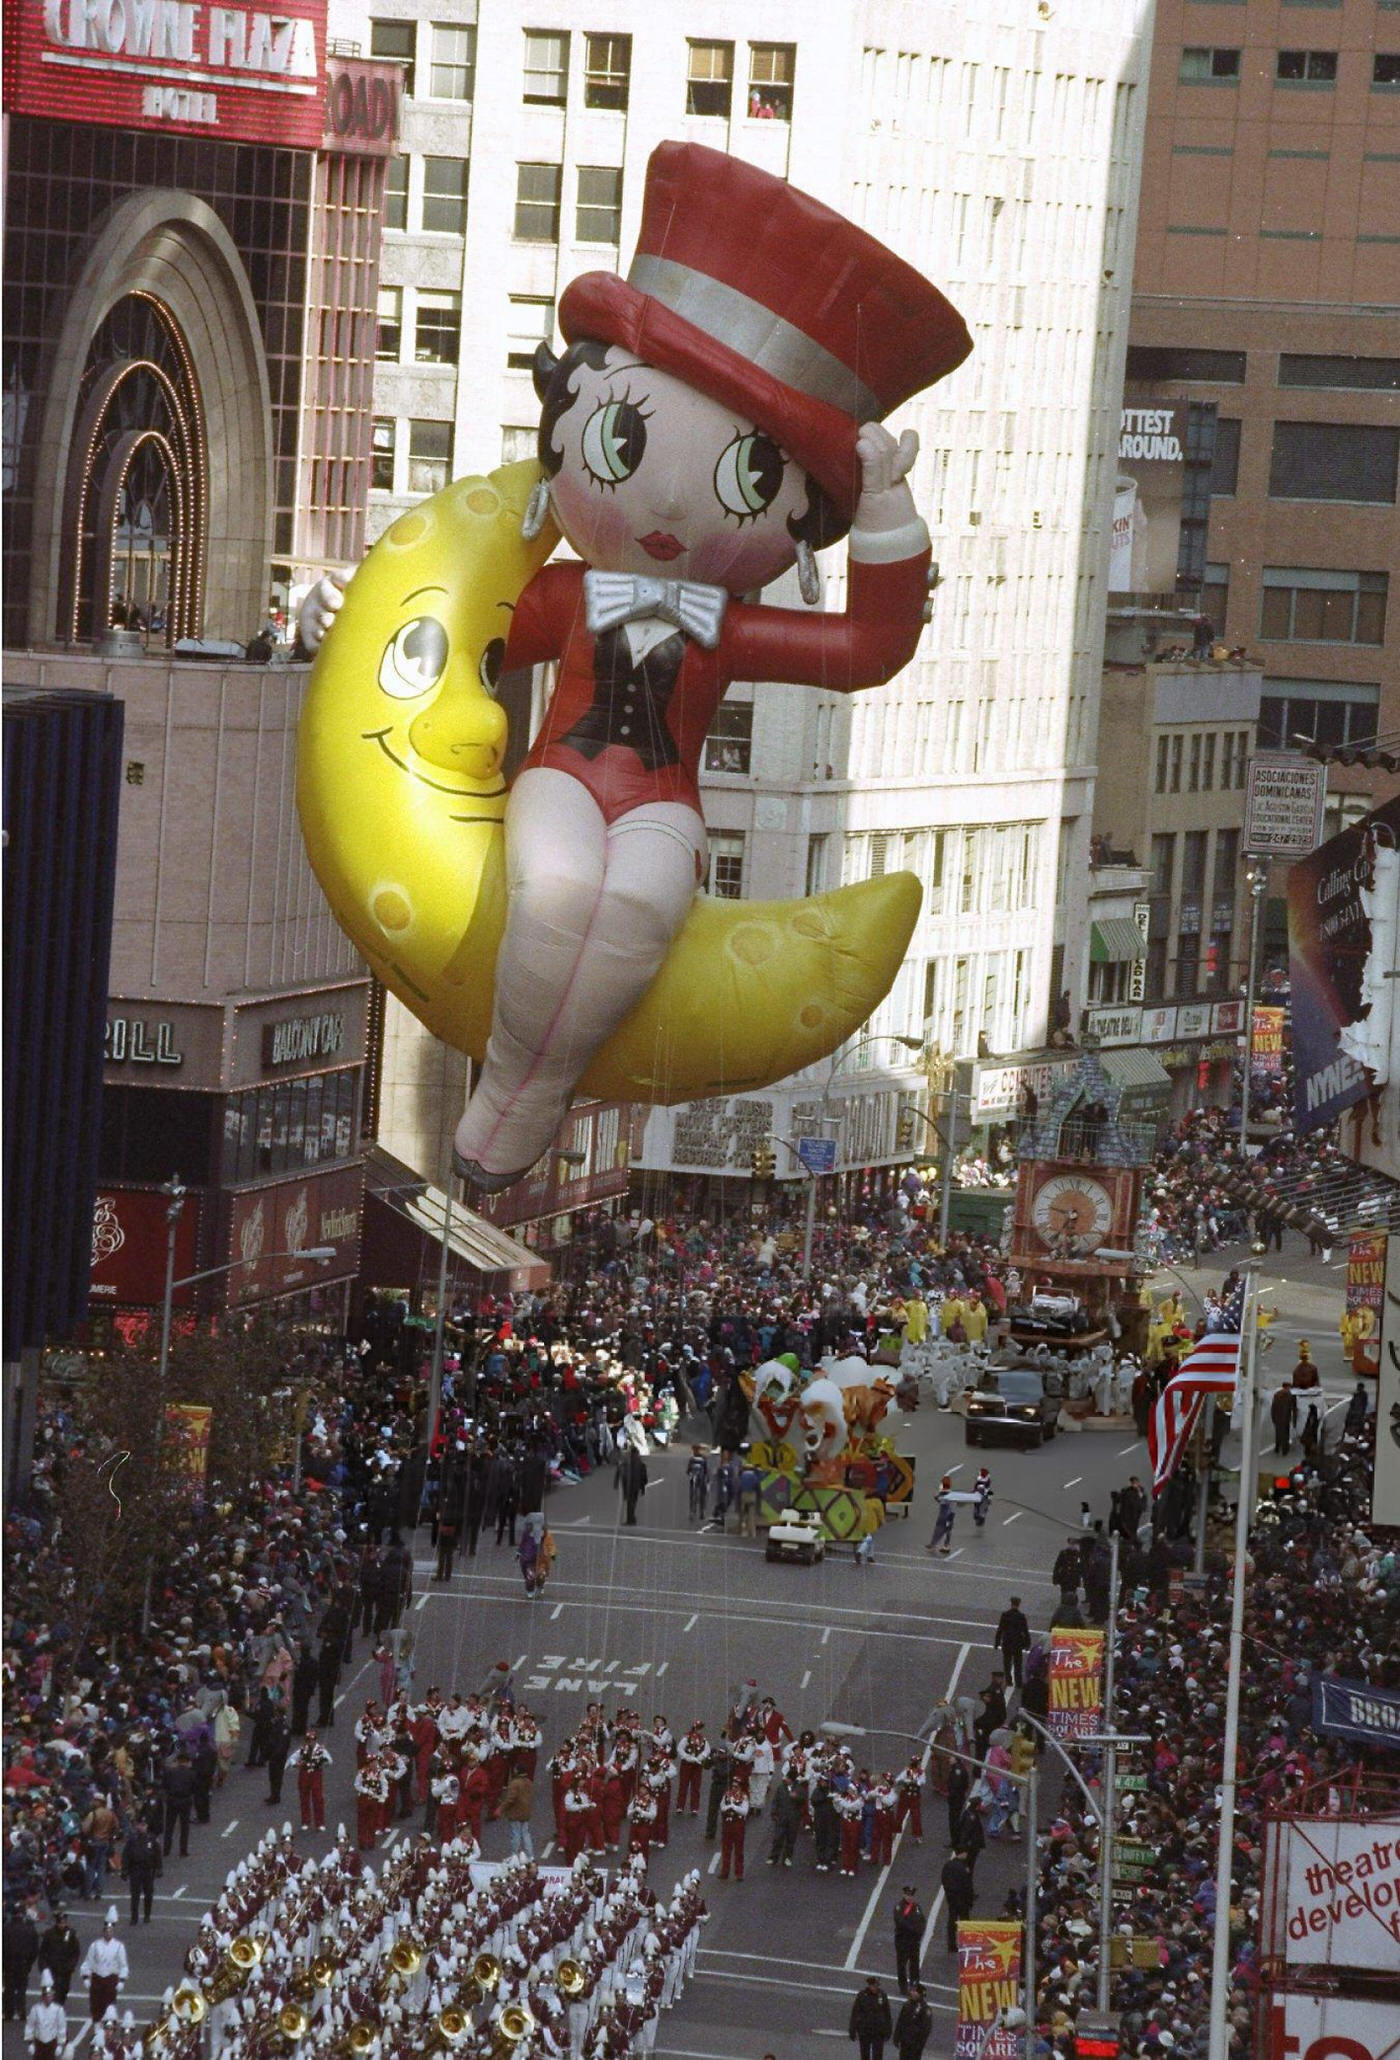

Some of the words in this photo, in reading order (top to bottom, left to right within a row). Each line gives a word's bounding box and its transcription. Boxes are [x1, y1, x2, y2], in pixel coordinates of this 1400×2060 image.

[43, 0, 201, 62] CROWNE
[208, 7, 317, 77] PLAZA
[141, 86, 219, 124] HOTEL
[1120, 409, 1175, 434] TTEST
[1254, 770, 1316, 786] ASOCIACIONES
[1317, 868, 1352, 905] Calling
[1350, 1261, 1385, 1285] NEW
[536, 1655, 653, 1676] FIRE
[1050, 1648, 1083, 1669] The
[522, 1675, 639, 1697] LANE
[1052, 1676, 1100, 1709] NEW
[1048, 1711, 1099, 1726] TIMES
[1350, 1695, 1400, 1731] BRO
[1305, 1839, 1400, 1897] theatr
[958, 1946, 996, 1970] The
[960, 1979, 1018, 2022] NEW
